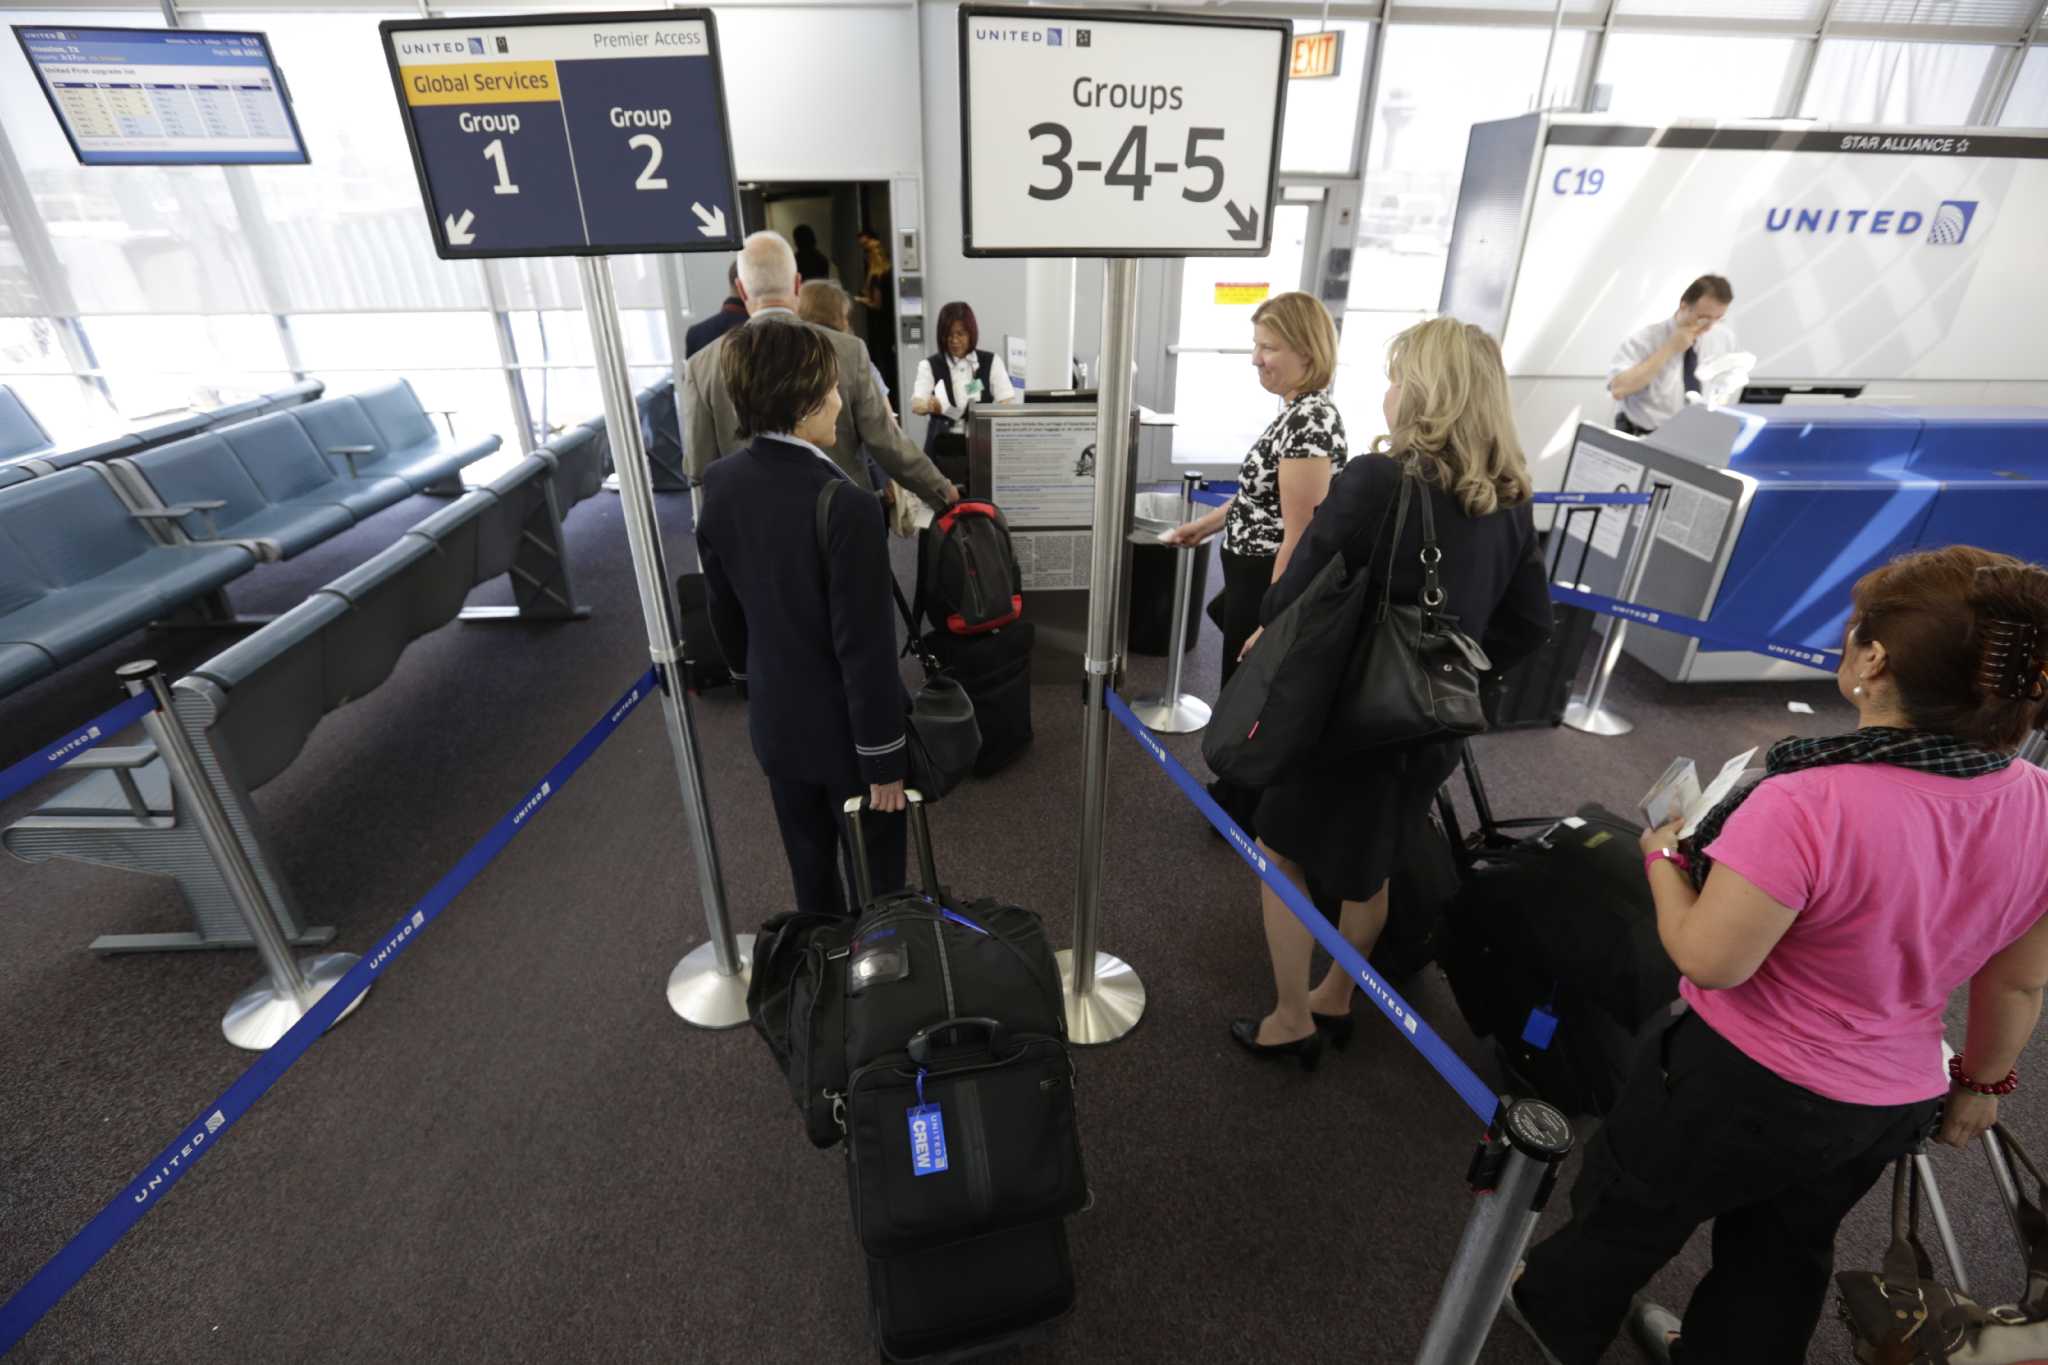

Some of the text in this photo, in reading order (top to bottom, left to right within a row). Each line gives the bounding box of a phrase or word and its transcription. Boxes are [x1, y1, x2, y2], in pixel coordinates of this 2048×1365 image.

[401, 41, 465, 55] UNITED
[593, 31, 702, 48] Premier Access
[975, 29, 1043, 43] UNITED
[1292, 32, 1334, 74] EXIT
[413, 71, 550, 95] Global Services
[1072, 77, 1184, 115] Groups
[459, 111, 521, 135] Group
[609, 106, 673, 130] Group
[1840, 135, 1955, 152] STAR ALLIANCE
[482, 138, 520, 195] 1
[627, 133, 669, 190] 2
[1027, 121, 1226, 203] 3-4-5
[1552, 168, 1605, 196] C19
[1765, 207, 1924, 235] UNITED
[1768, 644, 1811, 660] UNITED
[47, 736, 90, 762] UNITED
[513, 792, 543, 825] UNITED
[1230, 827, 1259, 860] UNITED
[369, 925, 413, 970] UNITED
[1361, 969, 1404, 1018] UNITED
[912, 1120, 932, 1168] CREW
[930, 1114, 942, 1158] UNITED
[134, 1132, 206, 1204] UNITED
